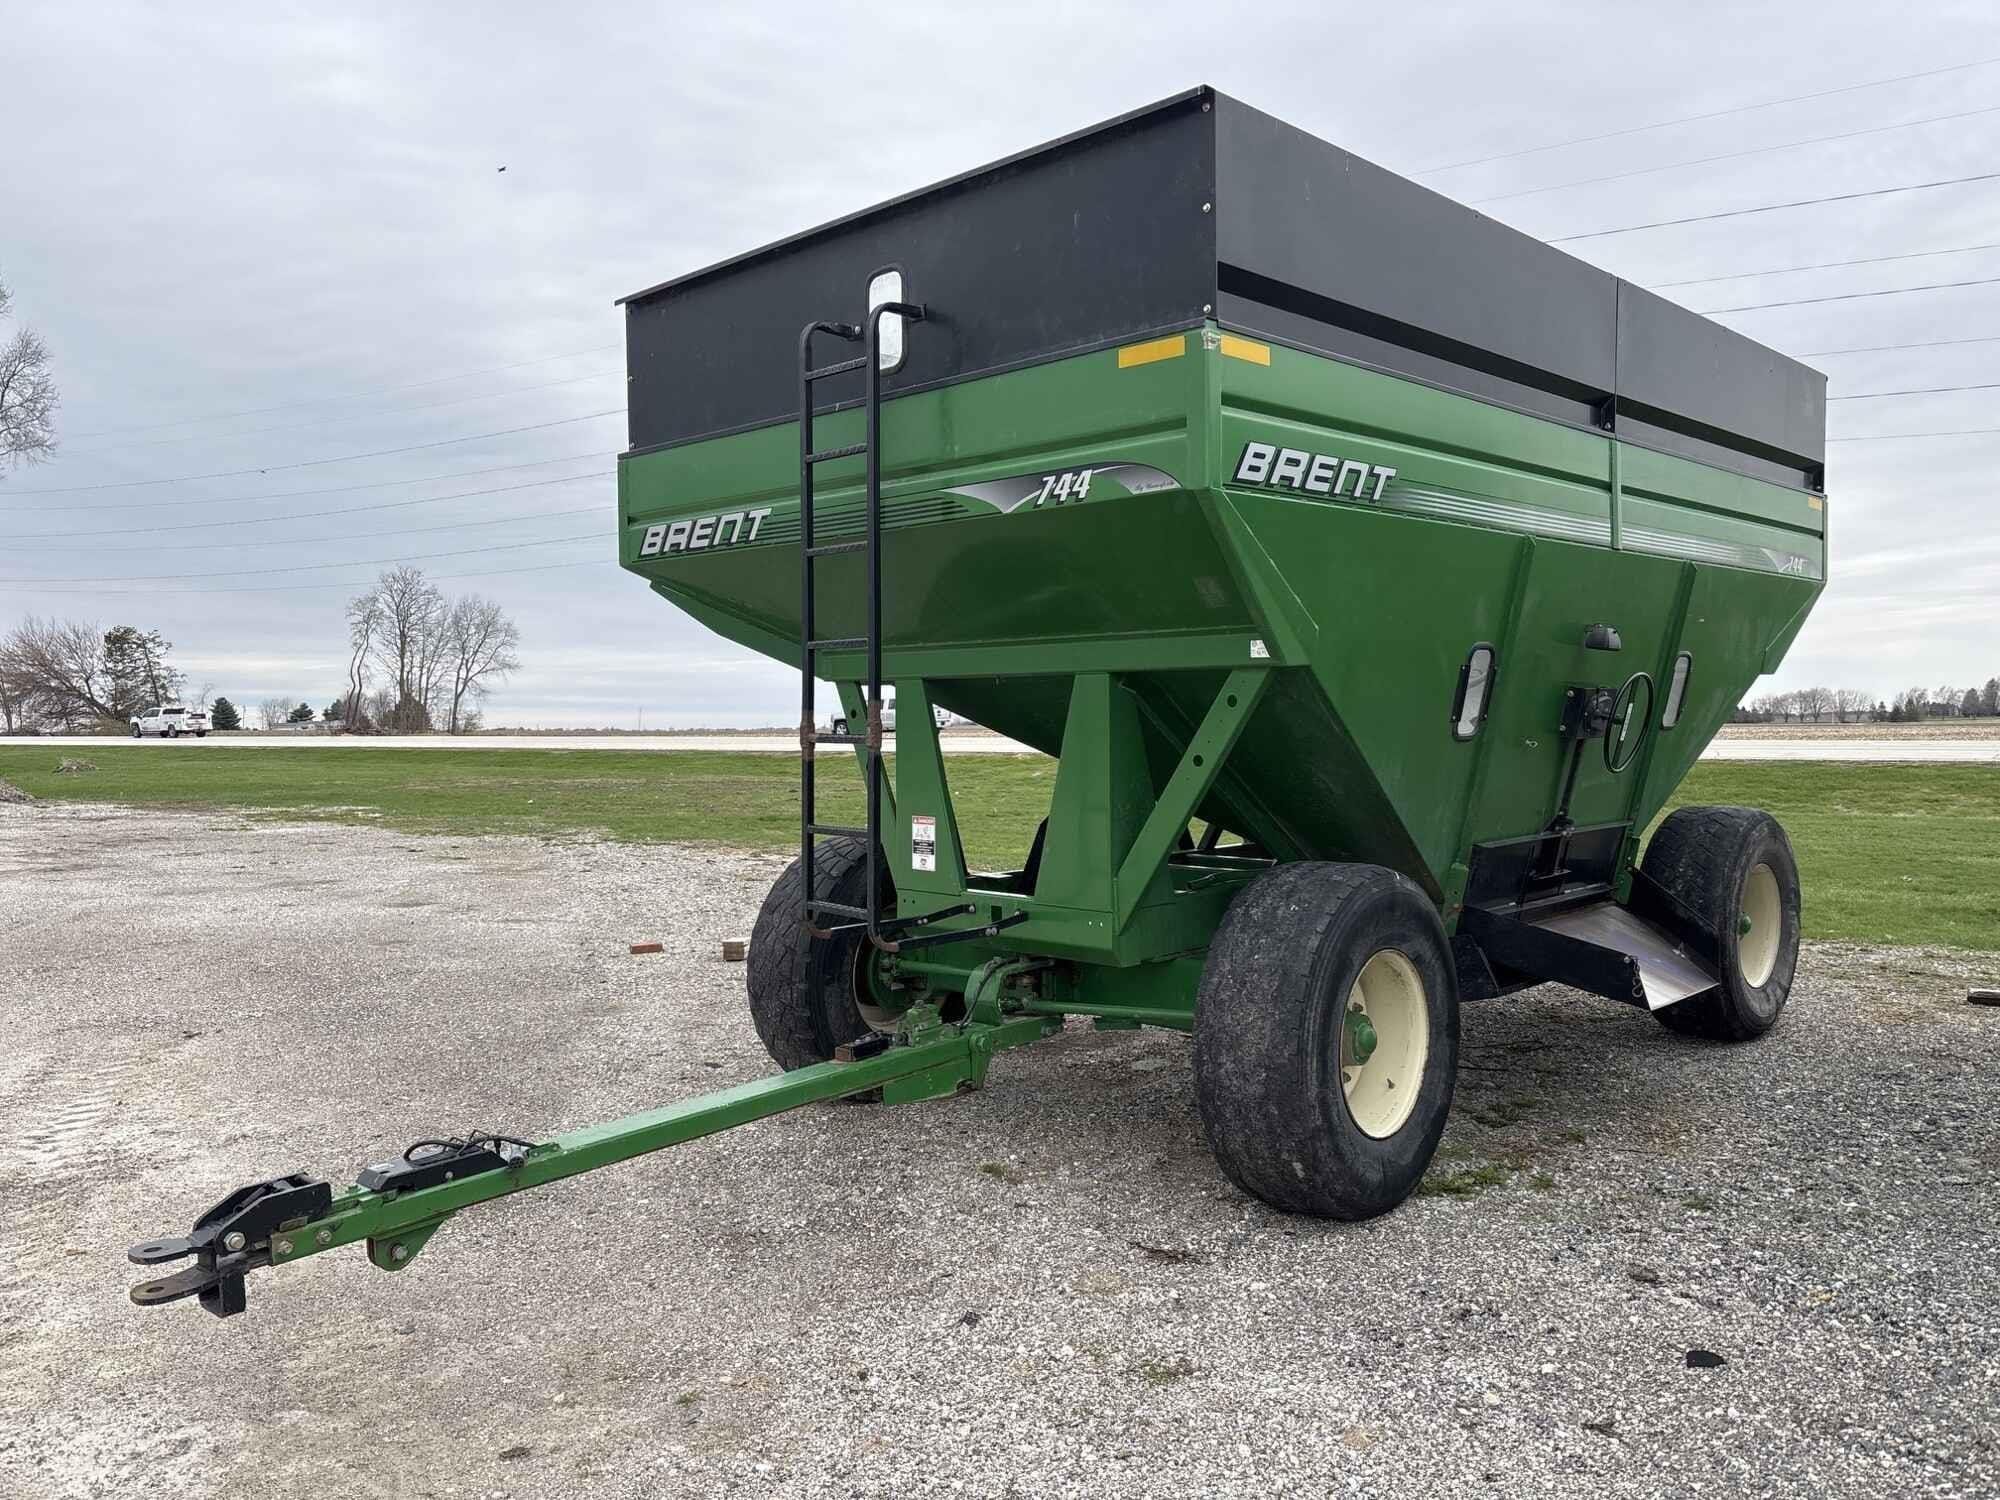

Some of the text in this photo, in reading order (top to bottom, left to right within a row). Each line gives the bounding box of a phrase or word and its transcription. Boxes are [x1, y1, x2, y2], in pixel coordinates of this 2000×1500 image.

[1036, 469, 1093, 505] 744
[1236, 441, 1398, 501] BRENT
[639, 507, 773, 556] BRENT
